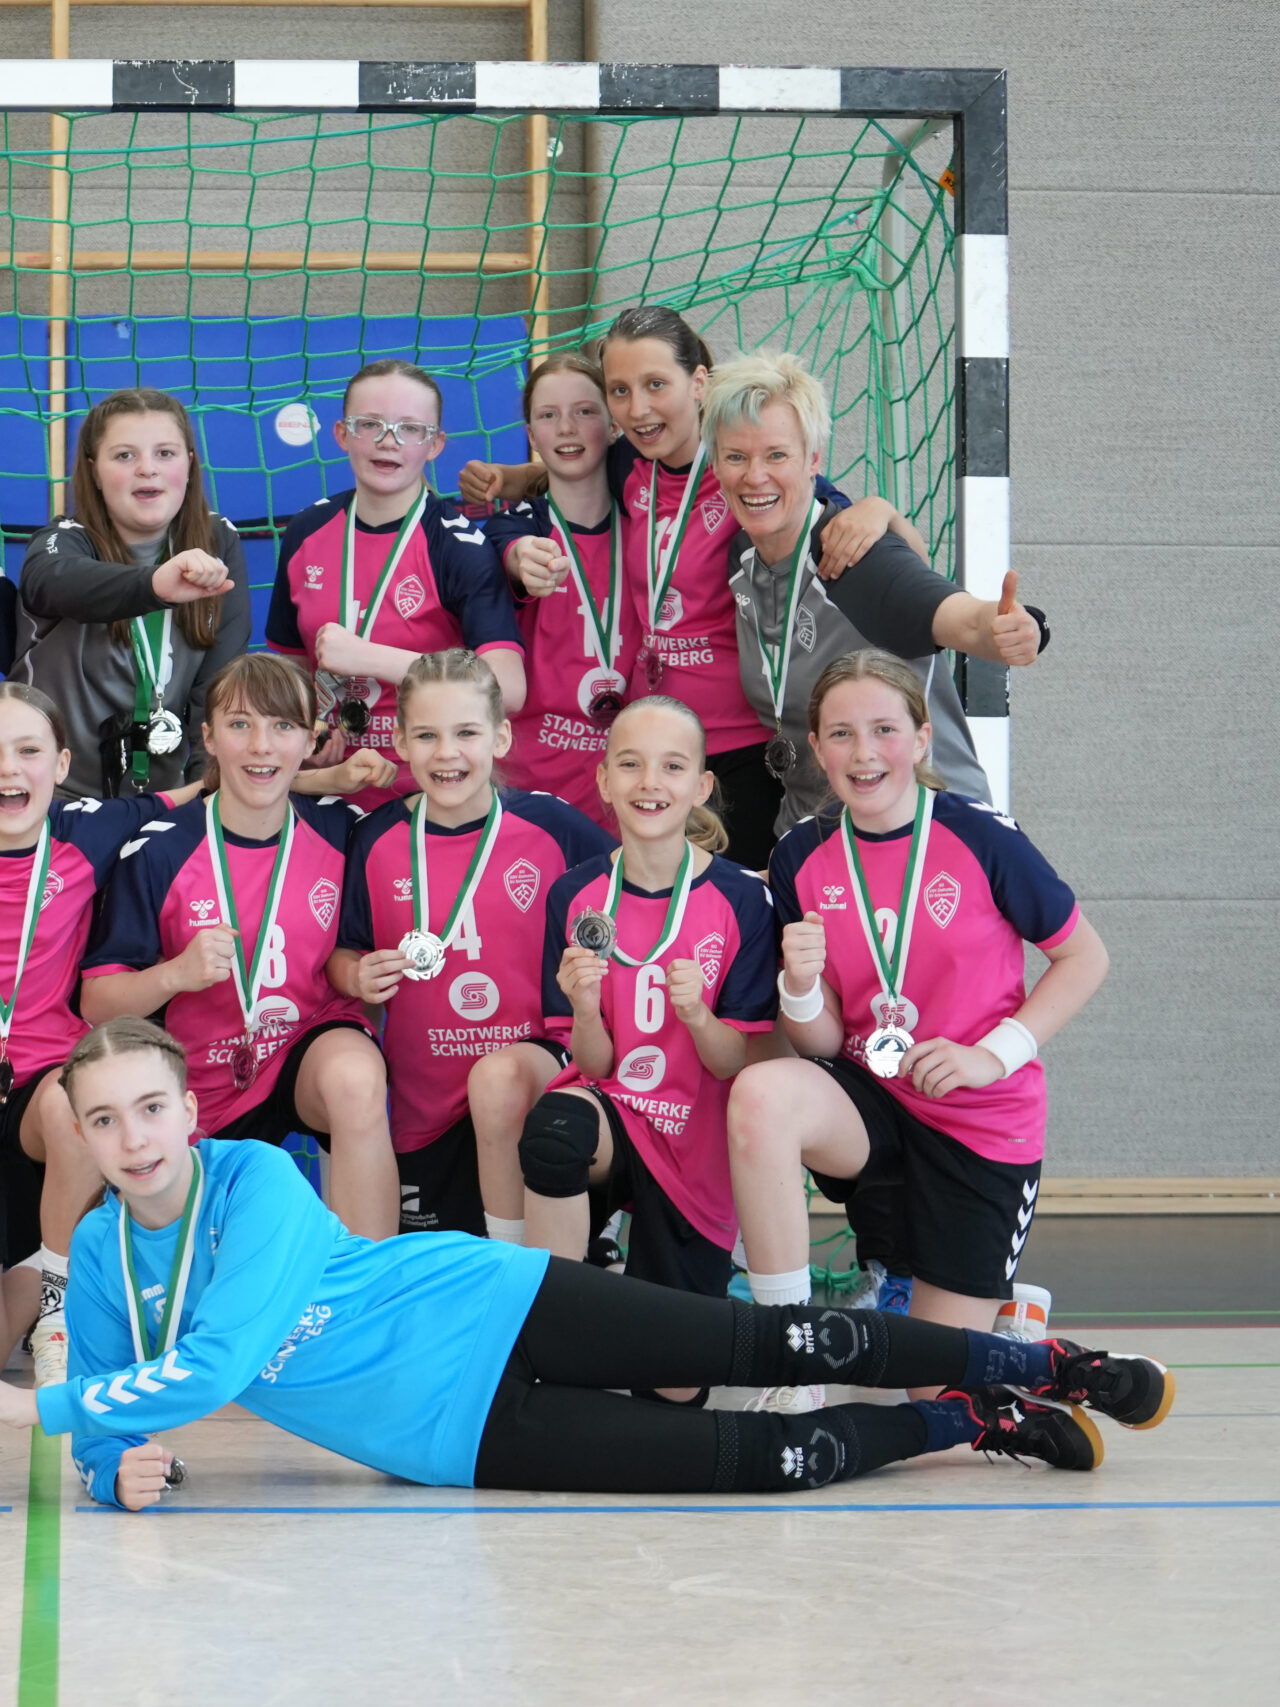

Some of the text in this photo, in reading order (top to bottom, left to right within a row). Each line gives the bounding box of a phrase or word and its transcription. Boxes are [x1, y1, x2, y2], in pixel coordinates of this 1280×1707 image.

[189, 917, 220, 927] hummel
[451, 896, 483, 961] 4
[634, 963, 666, 1034] 6
[427, 1021, 532, 1042] STADTWERKE
[802, 1322, 815, 1354] errea
[793, 1446, 805, 1479] errea
